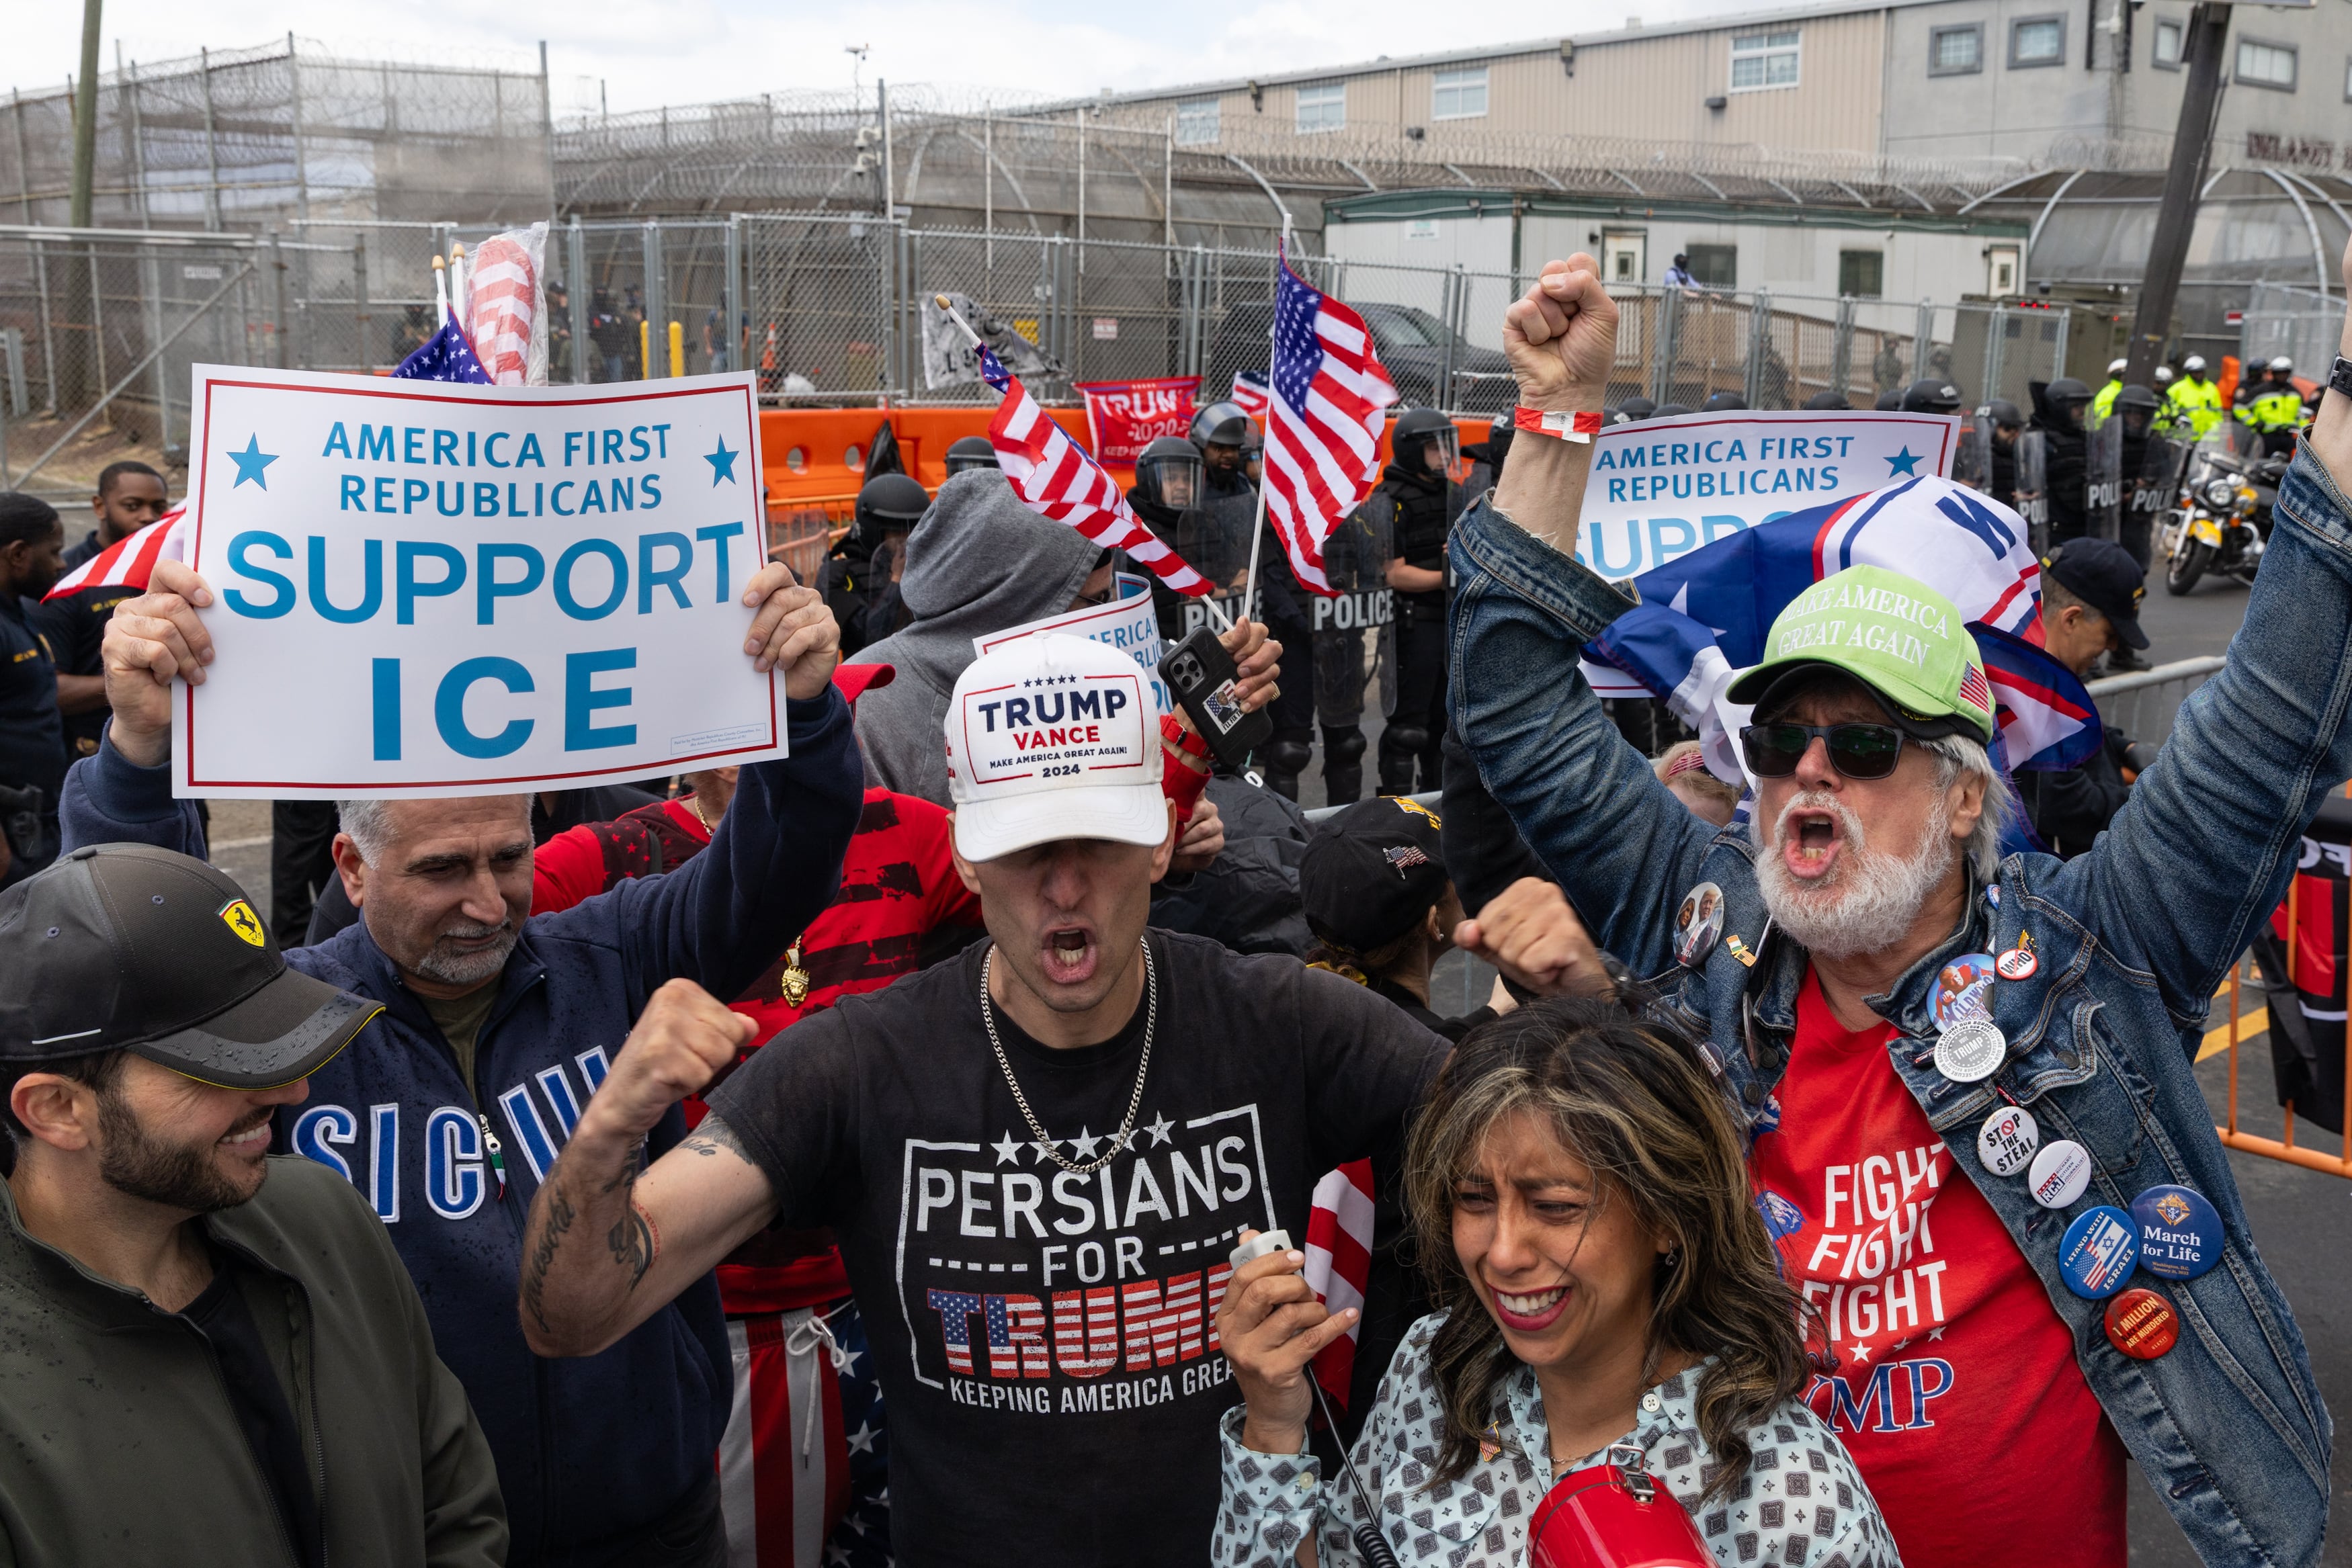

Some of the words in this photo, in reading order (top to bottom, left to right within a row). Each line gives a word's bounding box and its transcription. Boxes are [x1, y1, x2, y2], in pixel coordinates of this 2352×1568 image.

[1090, 389, 1179, 420] TRUM
[322, 421, 546, 468] AMERICA
[564, 423, 672, 467] FIRST
[1596, 439, 1747, 470] AMERICA
[1760, 436, 1855, 460] FIRST
[340, 474, 663, 518] REPUBLICANS
[1609, 466, 1839, 503] REPUBLICANS
[222, 521, 744, 625] SUPPORT
[1313, 589, 1394, 631] POLICE
[1777, 587, 1835, 625] MAKE
[1833, 584, 1949, 640] AMERICA
[1778, 621, 1846, 656] GREAT
[1845, 623, 1931, 669] AGAIN
[372, 646, 638, 761] ICE
[978, 689, 1127, 732] TRUMP
[1013, 726, 1101, 750] VANCE
[990, 758, 1013, 769] MAKE
[1016, 752, 1060, 765] AMERICA
[1064, 748, 1095, 758] GREAT
[1098, 746, 1127, 756] AGAIN!
[1042, 764, 1081, 778] 2024
[2001, 952, 2033, 975] WHO
[1954, 1037, 1983, 1060] TRUMP
[1986, 1113, 2021, 1147] STOP
[2001, 1132, 2019, 1151] THE
[1997, 1137, 2035, 1172] STEAL
[2056, 1156, 2072, 1174] RICHARD
[2060, 1162, 2074, 1178] CITIZEN
[2064, 1156, 2085, 1182] JOURNALIST
[916, 1135, 1252, 1238] PERSIANS
[1825, 1141, 1947, 1228] FIGHT
[1807, 1198, 1937, 1278] FIGHT
[2068, 1235, 2088, 1263] STAND
[2087, 1211, 2105, 1236] WITH
[2142, 1243, 2164, 1256] for
[2168, 1248, 2201, 1262] Life
[2144, 1225, 2201, 1246] March
[1042, 1236, 1146, 1287] FOR
[2103, 1248, 2135, 1291] ISRAEL
[1798, 1260, 1947, 1342] FIGHT
[2113, 1327, 2122, 1336] 1
[2119, 1296, 2159, 1332] MILLION
[2126, 1335, 2140, 1348] ARE
[2137, 1311, 2169, 1339] MURDERED
[950, 1377, 1051, 1413] KEEPING
[1060, 1375, 1175, 1414] AMERICA
[1183, 1356, 1236, 1396] GREA
